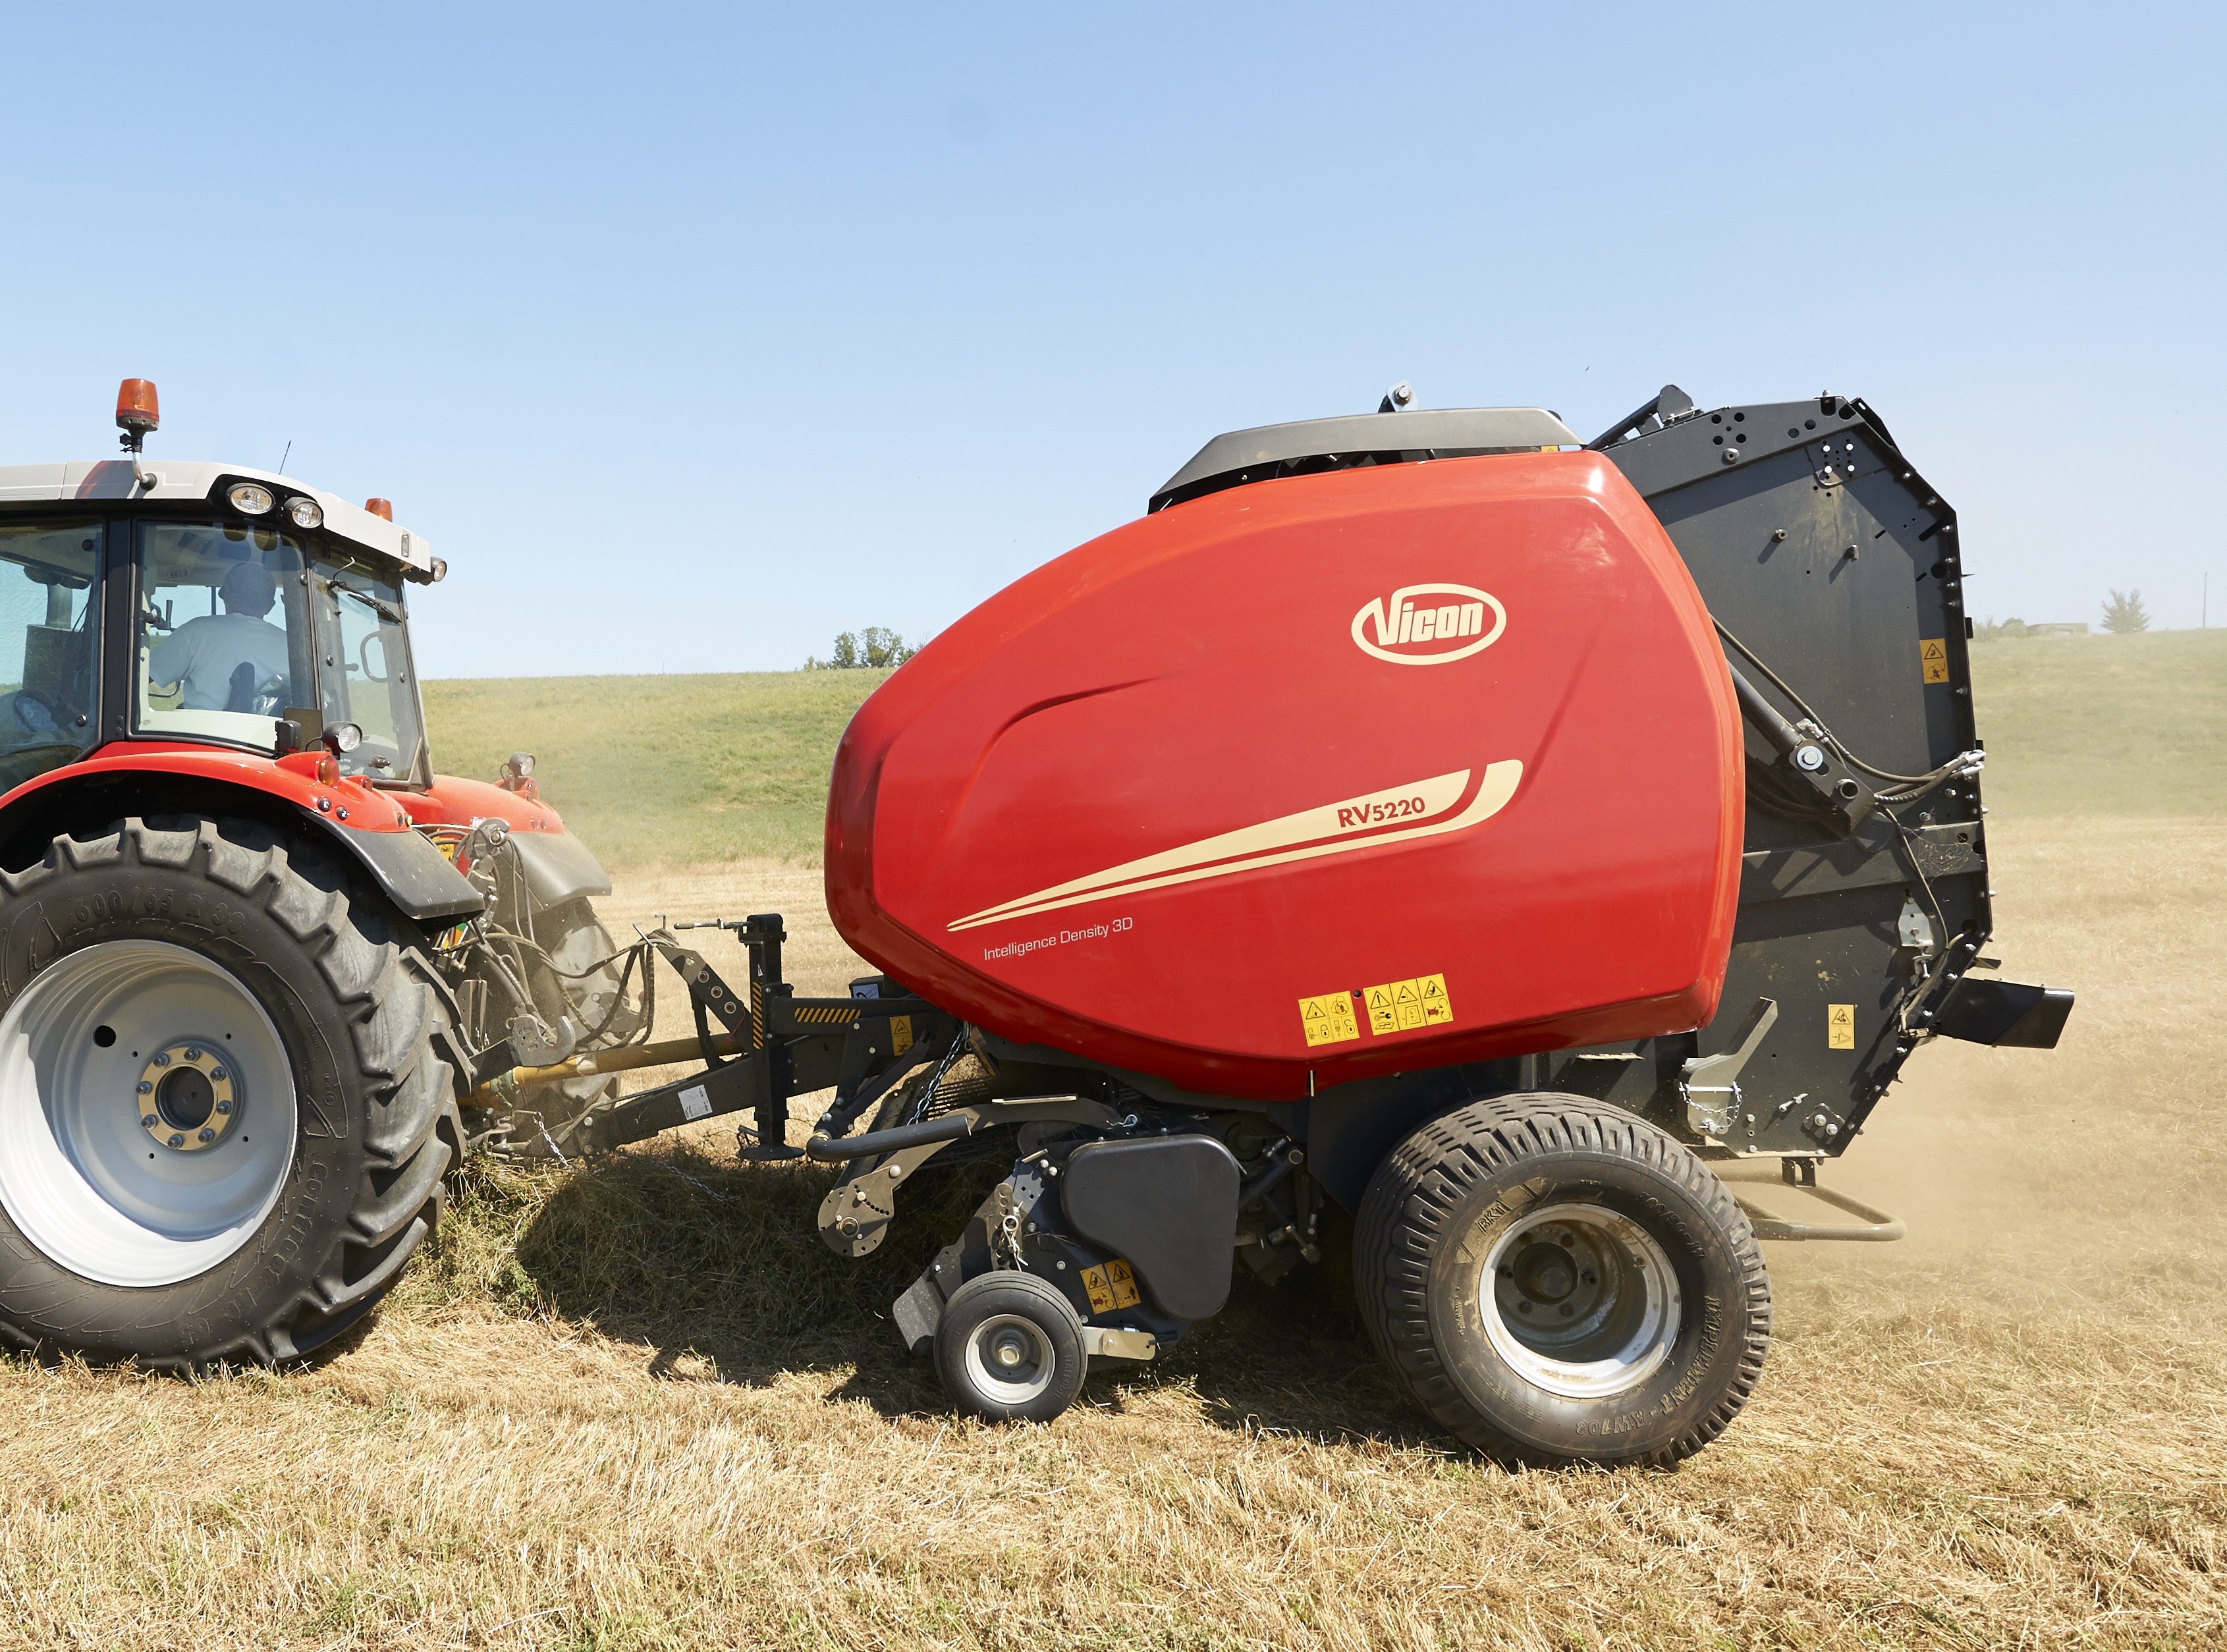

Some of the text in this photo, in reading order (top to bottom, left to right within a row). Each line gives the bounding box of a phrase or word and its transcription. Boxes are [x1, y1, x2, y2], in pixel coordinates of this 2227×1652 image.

[1370, 590, 1484, 646] Vicon
[1337, 796, 1425, 828] RV5220
[984, 917, 1134, 960] Intelligence Density 3D
[1479, 1202, 1508, 1232] BKT
